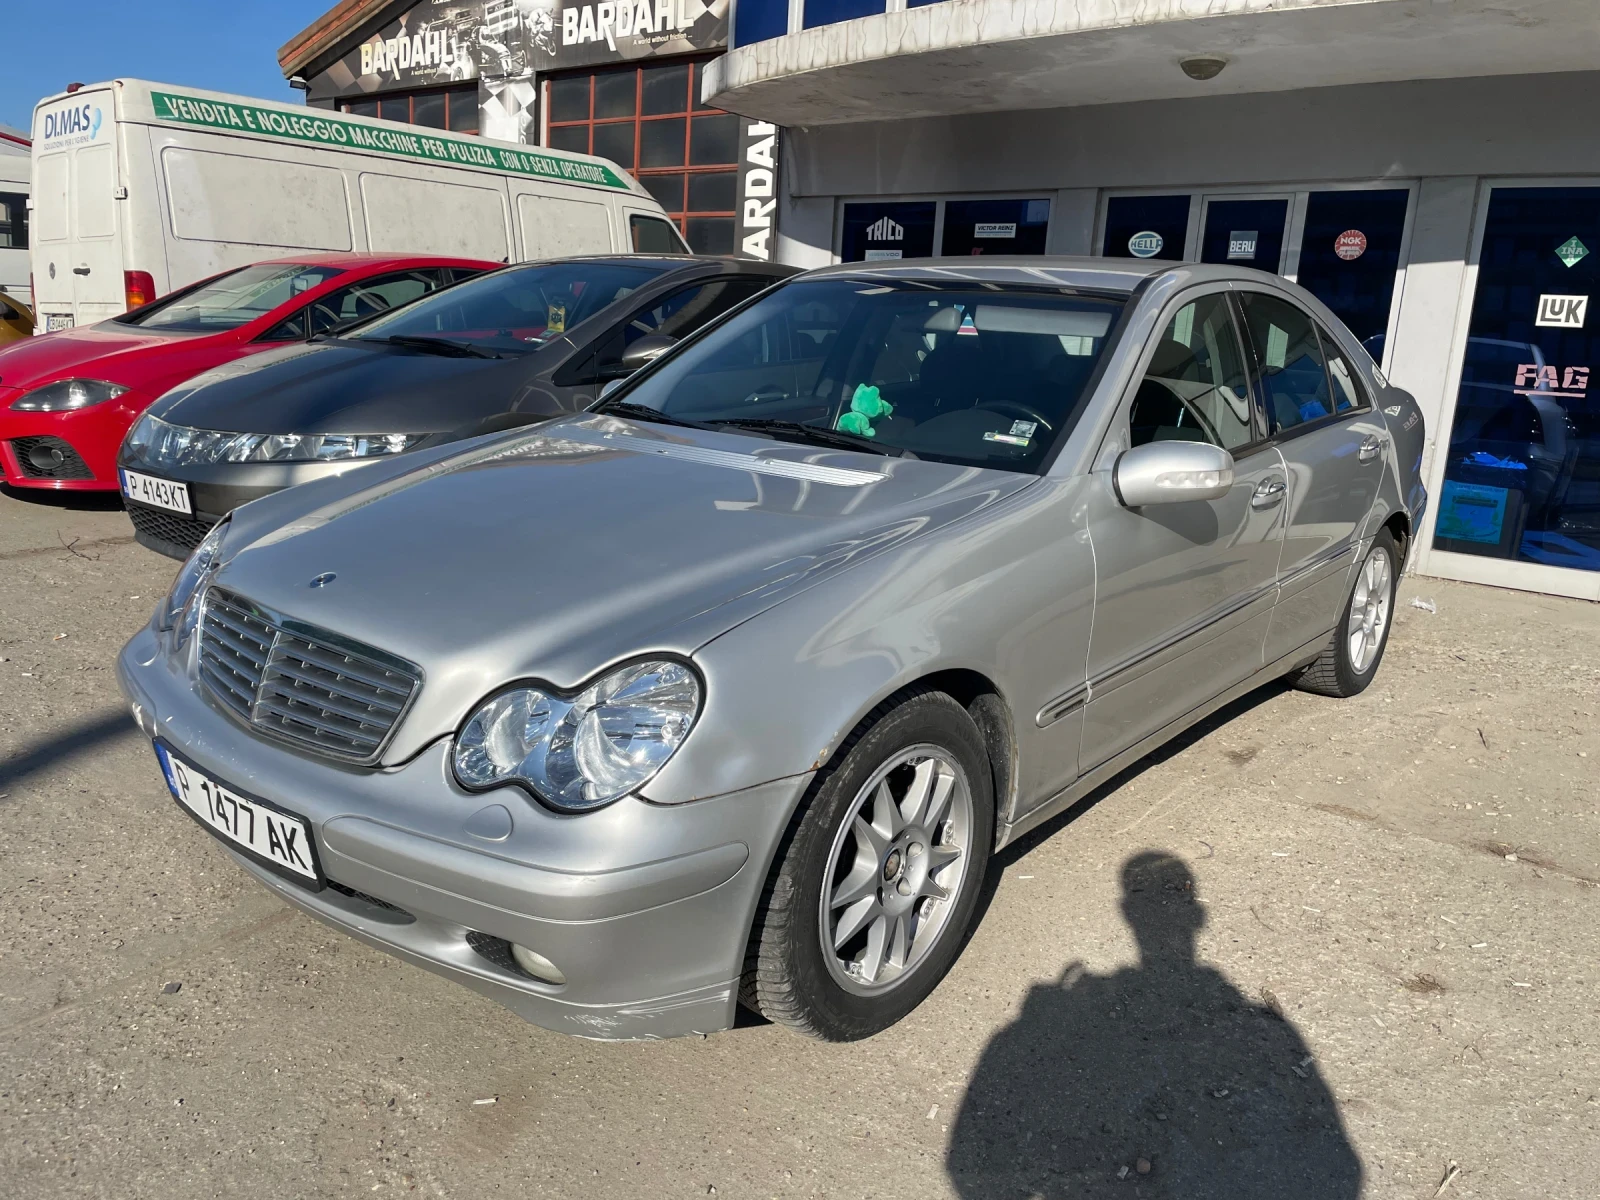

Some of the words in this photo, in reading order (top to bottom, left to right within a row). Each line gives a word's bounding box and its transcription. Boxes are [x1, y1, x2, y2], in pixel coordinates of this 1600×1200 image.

[562, 0, 695, 51] BARDAHL
[638, 37, 651, 45] world
[651, 34, 669, 43] without
[670, 32, 687, 40] friction
[361, 27, 453, 81] BARDAHL
[44, 104, 90, 139] DI.MAS
[163, 96, 240, 127] VENDITA
[242, 110, 256, 129] E
[256, 112, 347, 143] NOLEGGIO
[349, 127, 422, 154] MACCHINE
[422, 137, 447, 158] PER
[448, 142, 497, 166] PULIZIA
[500, 150, 521, 170] CON
[523, 155, 530, 171] O
[529, 156, 560, 175] SENZA
[560, 161, 608, 183] OPERATORE
[742, 121, 777, 261] ARDA
[866, 216, 904, 241] TRICO
[1340, 236, 1362, 244] NGK
[1130, 238, 1162, 249] HELLA
[1229, 240, 1255, 252] BERU
[1560, 246, 1584, 255] INA
[1514, 363, 1590, 389] FAG
[129, 474, 137, 497] P
[174, 761, 190, 800] P
[200, 780, 255, 845] 1477
[266, 815, 309, 871] AK
